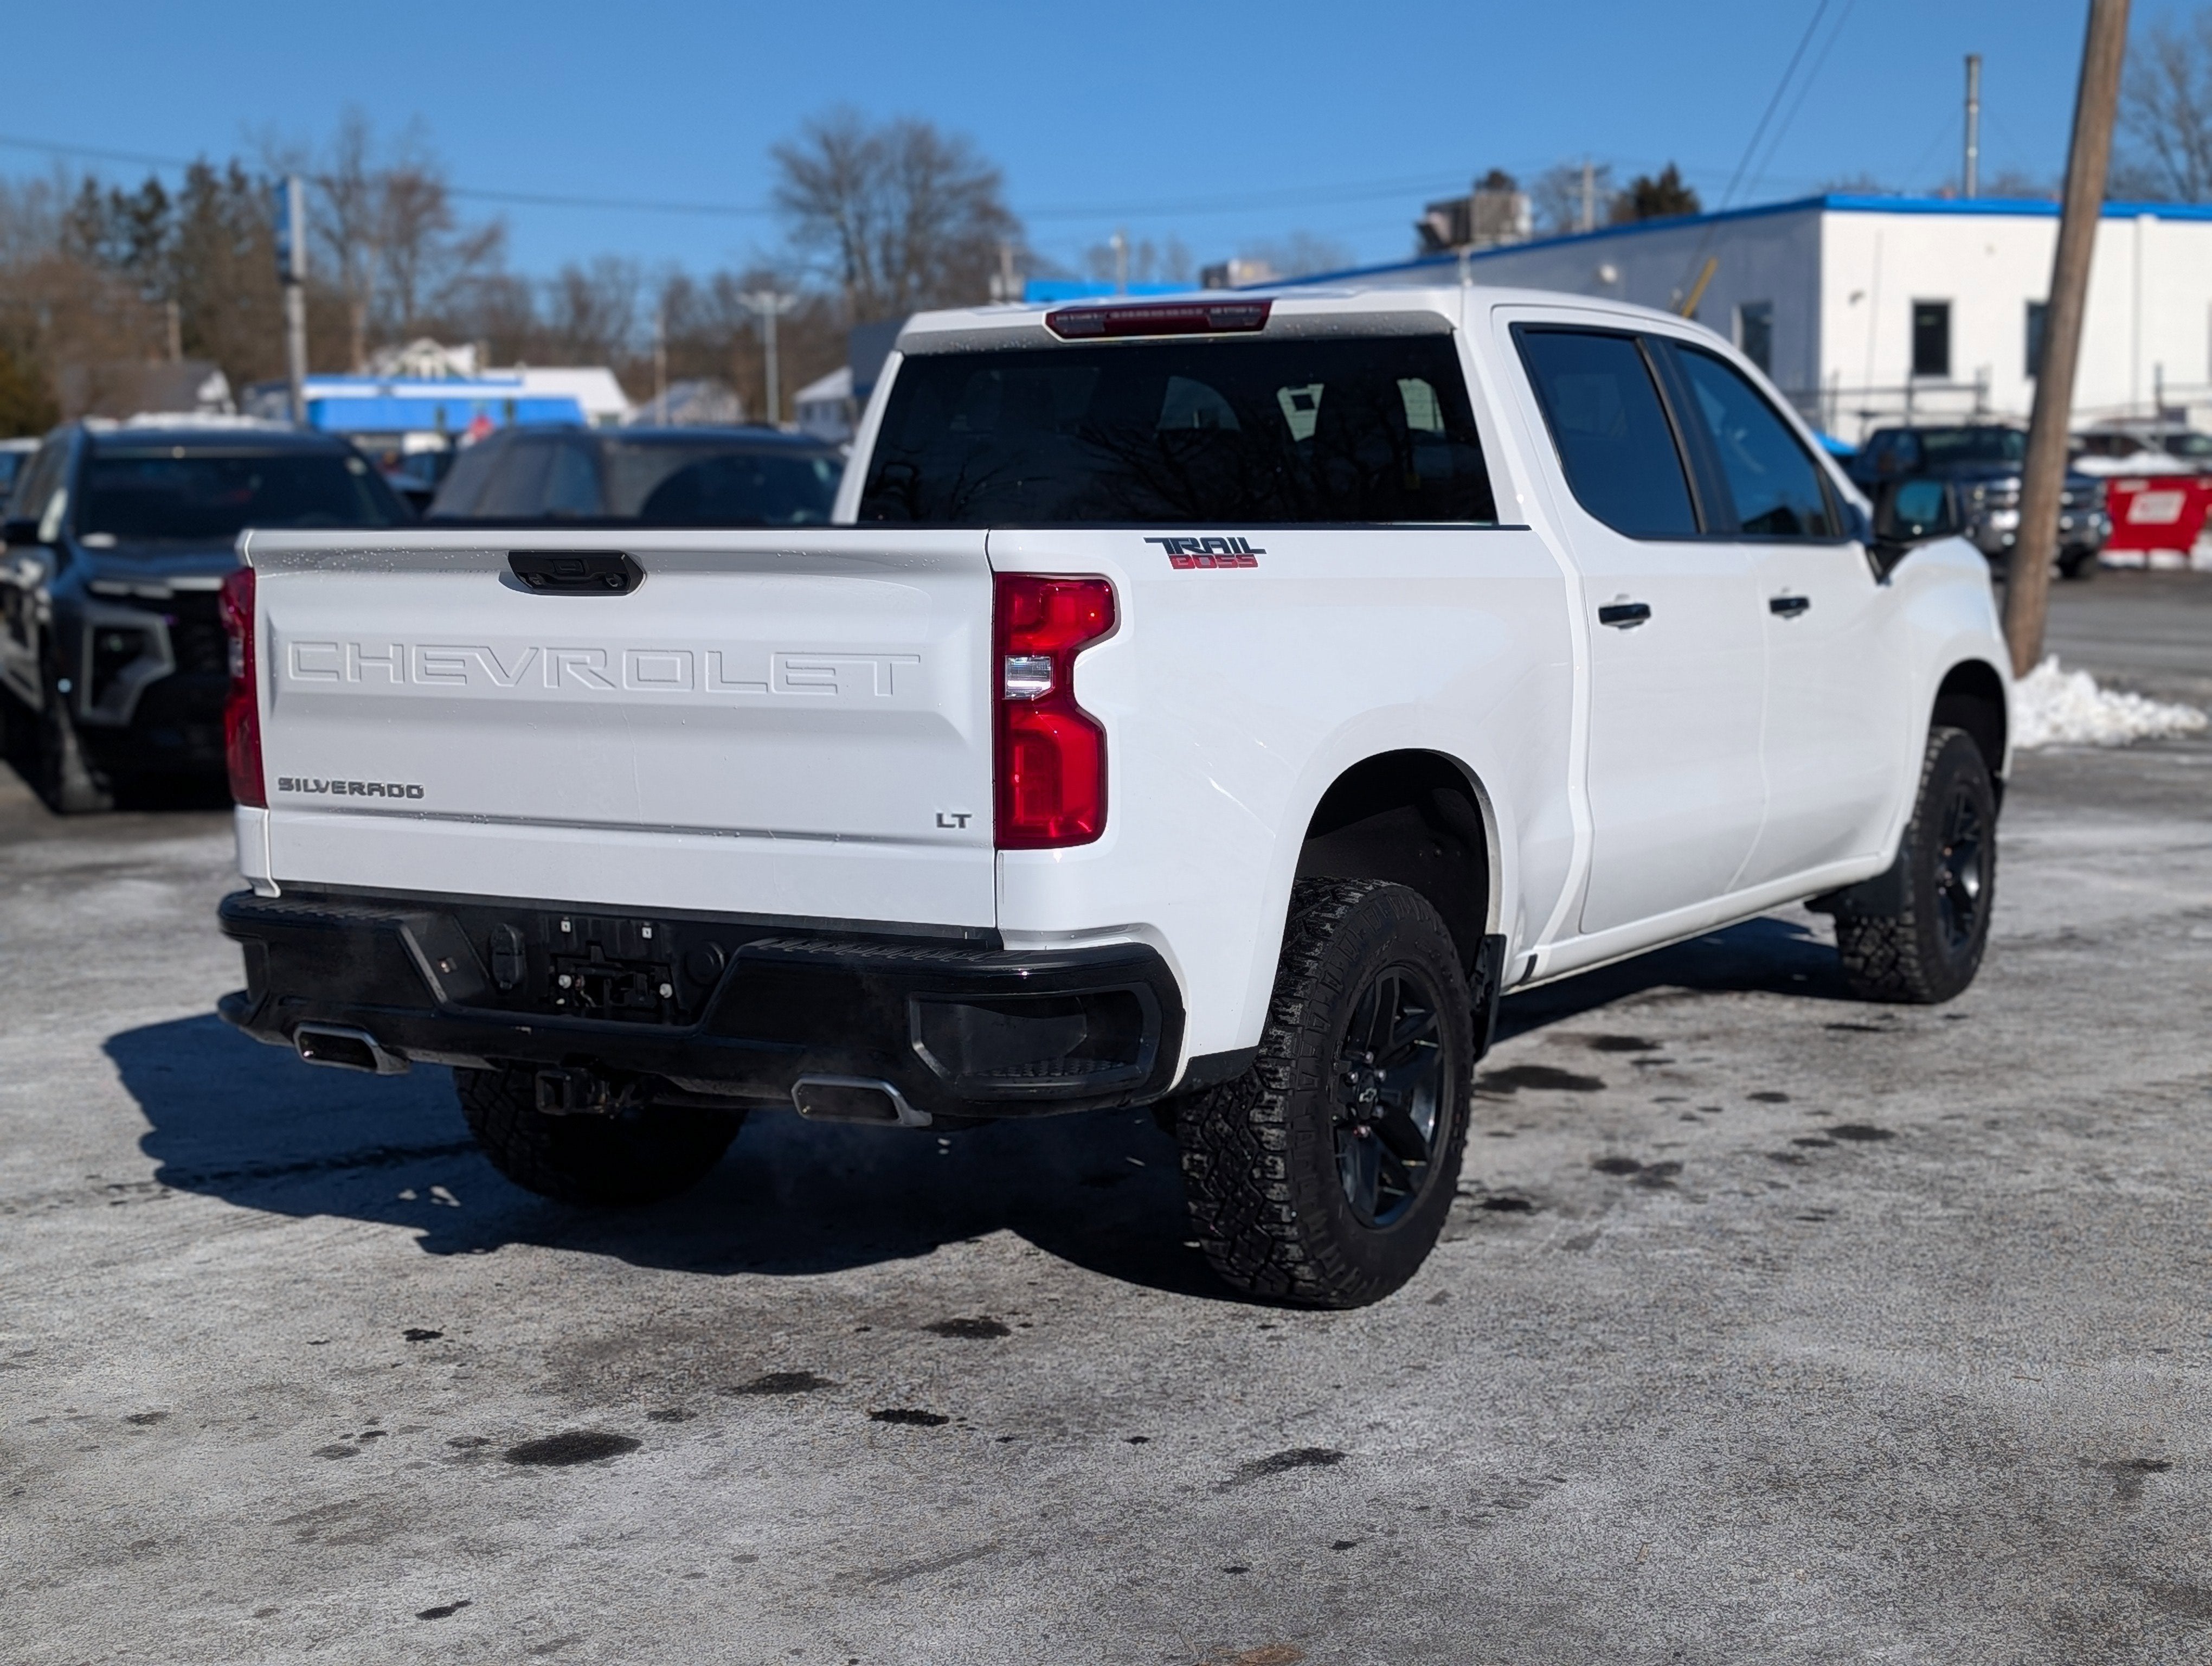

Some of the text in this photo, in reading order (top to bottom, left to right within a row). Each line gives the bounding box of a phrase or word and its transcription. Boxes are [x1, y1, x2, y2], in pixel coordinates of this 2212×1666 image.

[1143, 537, 1267, 554] TRAIL
[1168, 554, 1258, 569] BOSS
[288, 641, 920, 696] CHEVROLET
[278, 777, 425, 799] SILVERADO
[936, 813, 972, 828] LT
